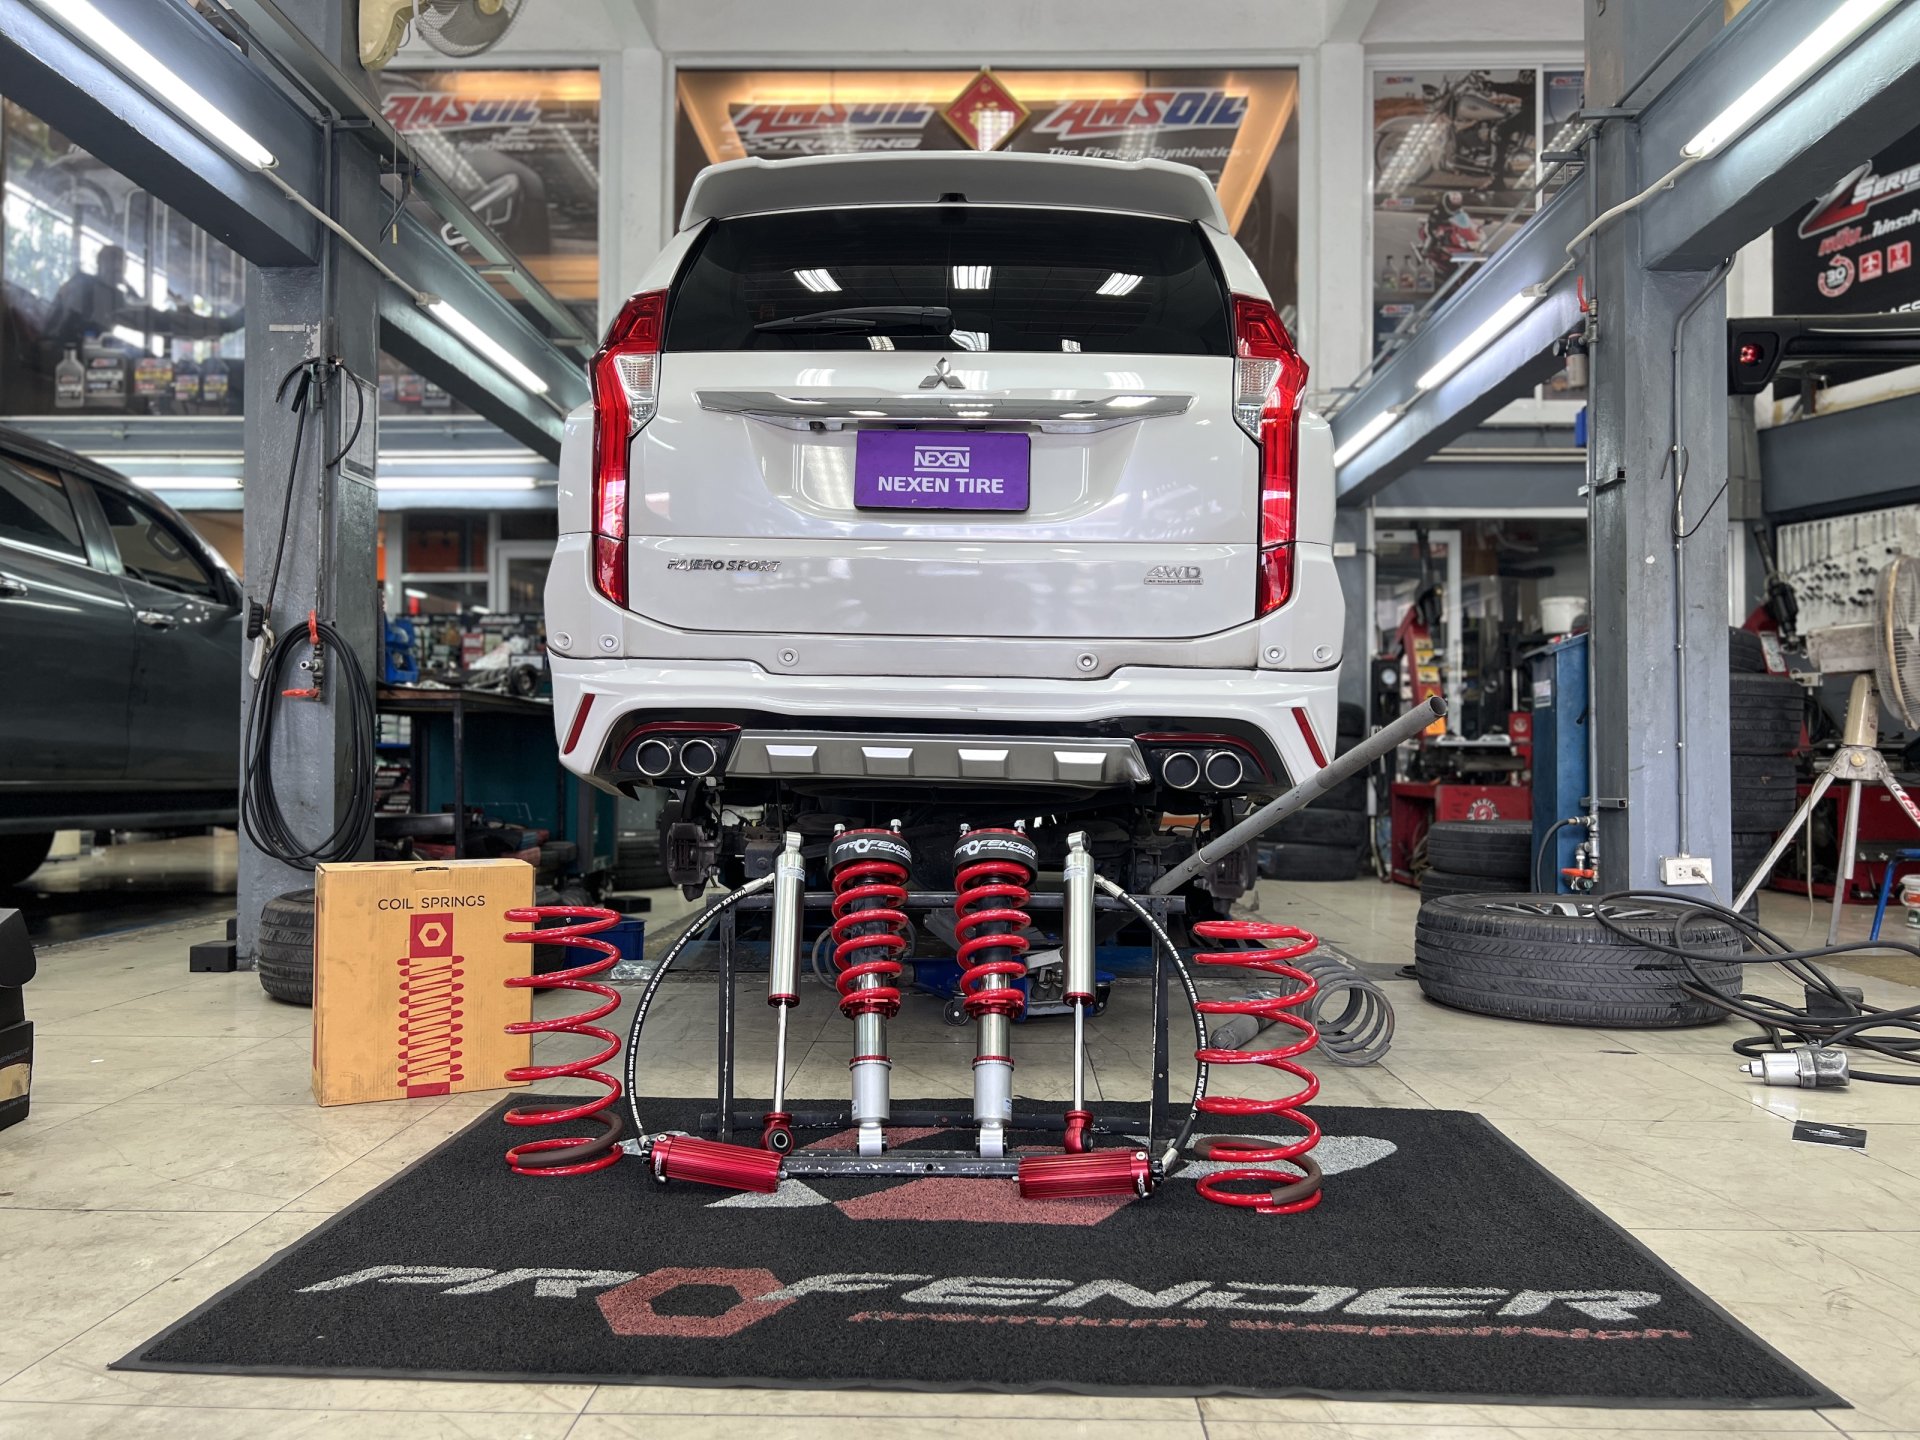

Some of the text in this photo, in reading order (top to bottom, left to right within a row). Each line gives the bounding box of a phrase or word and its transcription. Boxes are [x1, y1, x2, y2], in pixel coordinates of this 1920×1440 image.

[382, 93, 541, 135] AMSOIL
[728, 101, 934, 138] AMSOIL
[1032, 88, 1249, 140] AMSOIL
[1826, 266, 1846, 281] 30
[914, 450, 970, 468] NEXEN
[878, 476, 1004, 494] NEXEN TIRE
[667, 558, 781, 572] PAJERO SPORT
[1147, 565, 1201, 579] 4WD
[954, 839, 1036, 859] PROFENDER
[378, 895, 486, 910] COIL SPRINGS
[295, 1263, 1662, 1339] PROFENDER
